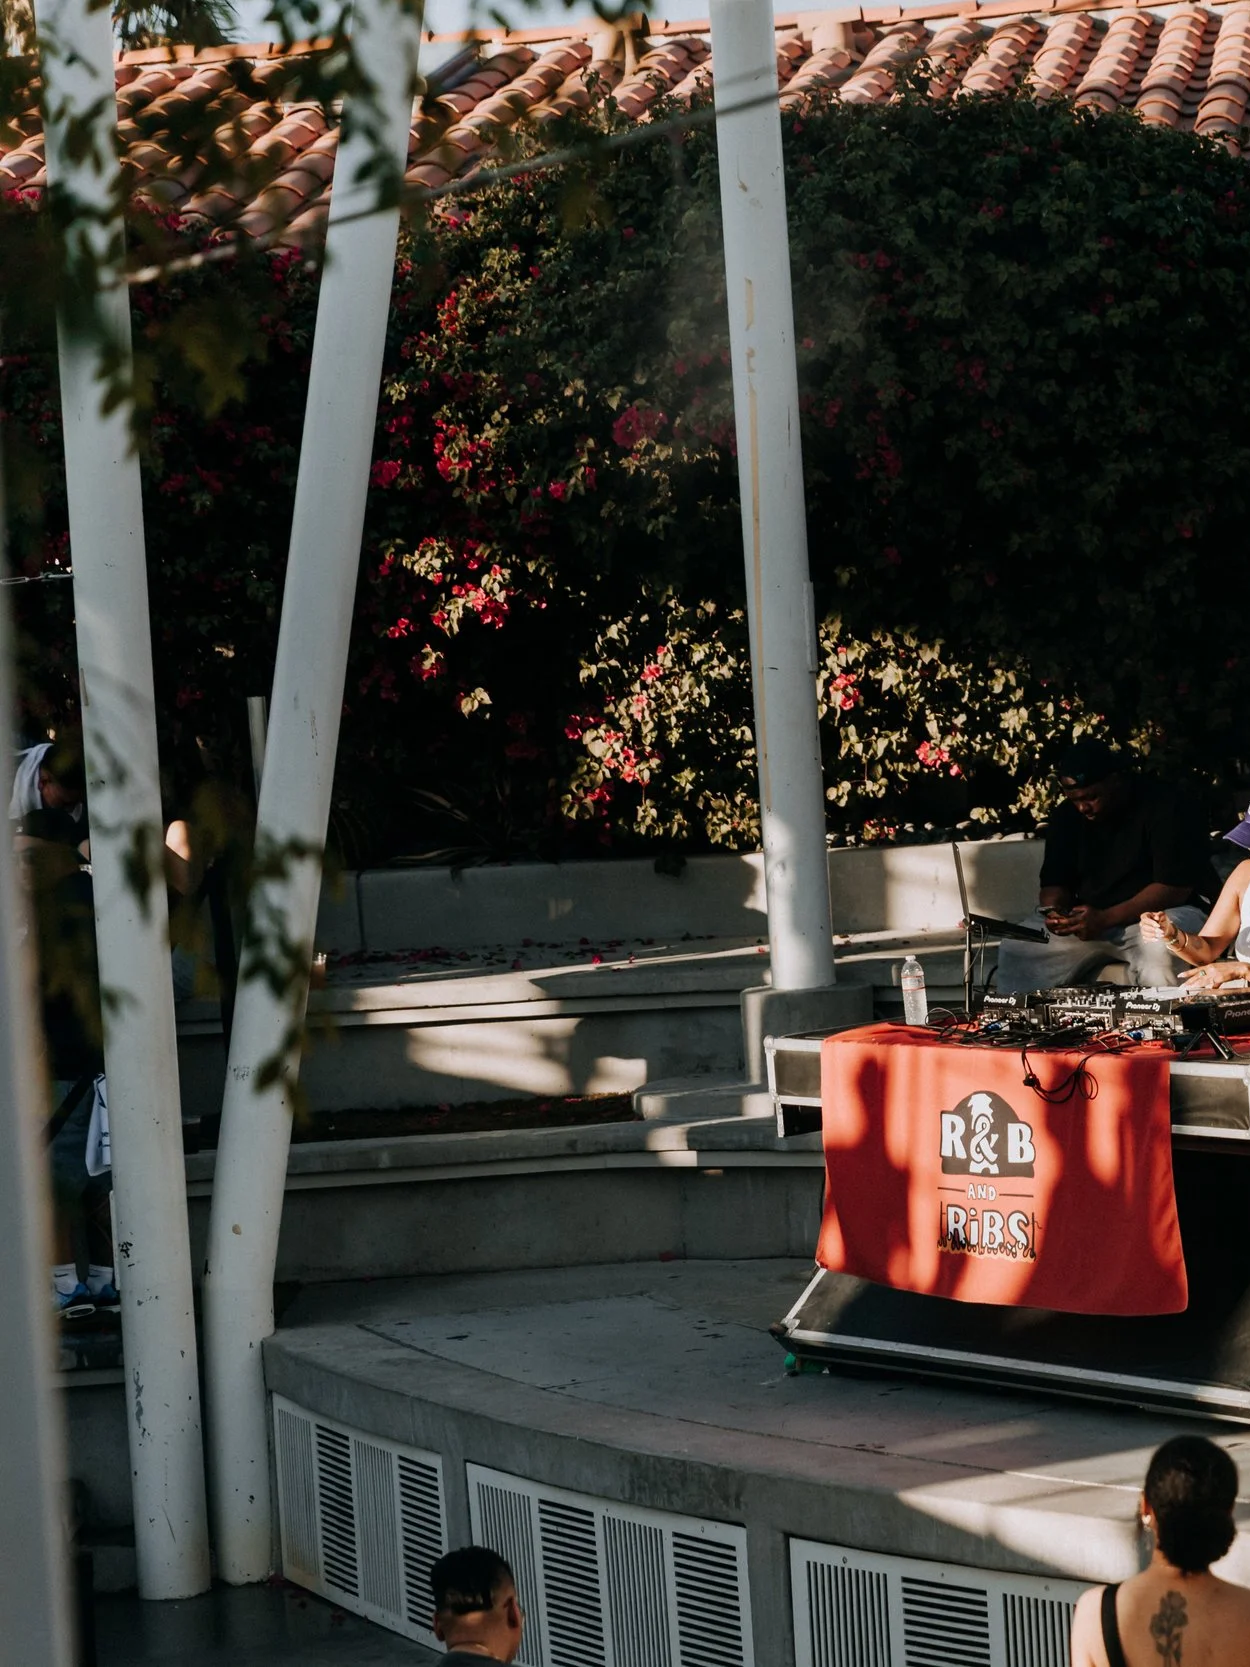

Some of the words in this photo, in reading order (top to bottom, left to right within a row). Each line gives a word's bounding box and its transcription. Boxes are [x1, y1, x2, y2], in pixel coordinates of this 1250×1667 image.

[983, 995, 1009, 1004] Pioneer
[1125, 1001, 1152, 1010] Pioneer
[940, 1112, 1036, 1165] R&B
[967, 1183, 997, 1201] AND
